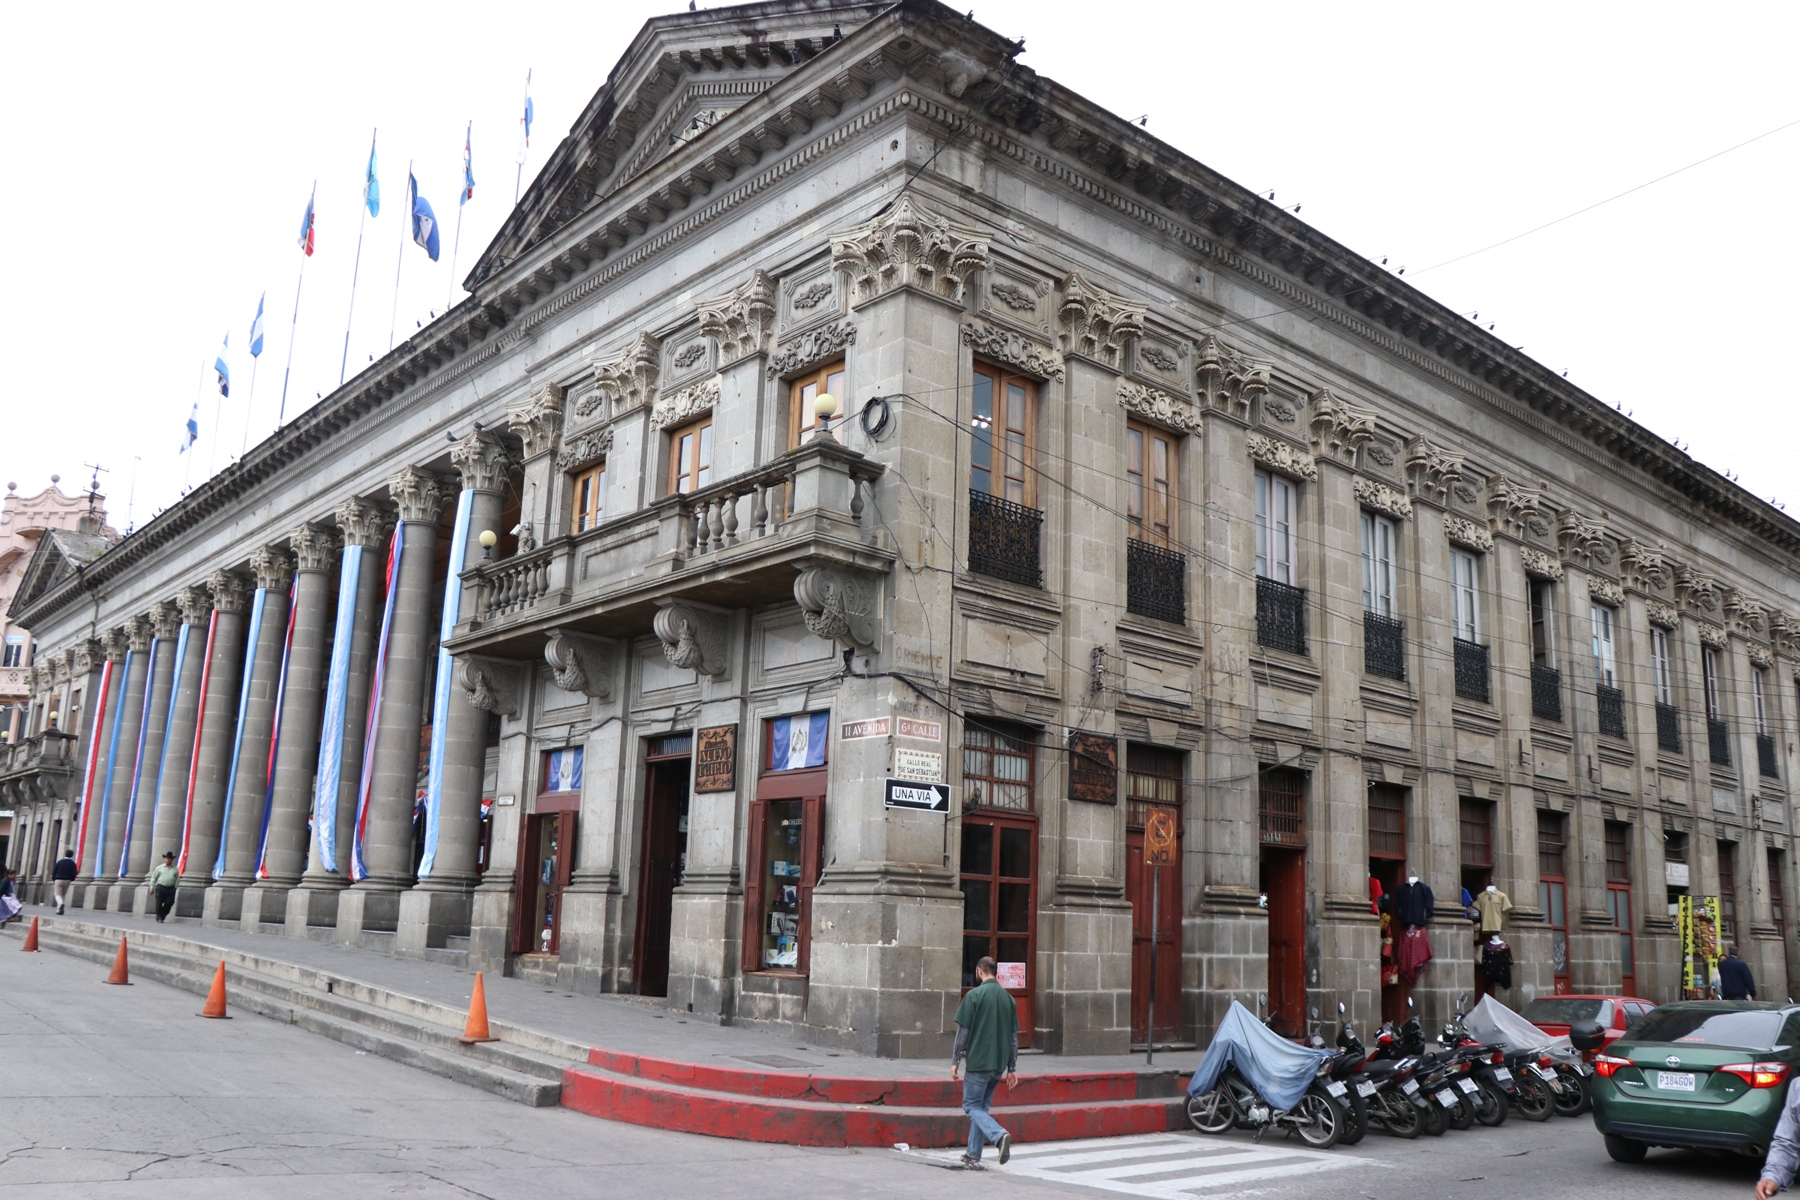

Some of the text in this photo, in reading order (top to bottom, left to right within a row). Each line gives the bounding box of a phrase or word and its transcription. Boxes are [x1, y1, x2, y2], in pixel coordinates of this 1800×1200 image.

[845, 721, 886, 736] 11 AVENIDA
[912, 723, 938, 738] CALLE
[700, 746, 732, 762] NUEVO
[698, 760, 732, 778] EGIPTO
[906, 758, 932, 768] CALLE REAL
[900, 766, 938, 777] DE SAN SEBASTIAN
[895, 787, 931, 801] UNA VIA
[1151, 849, 1169, 862] NO
